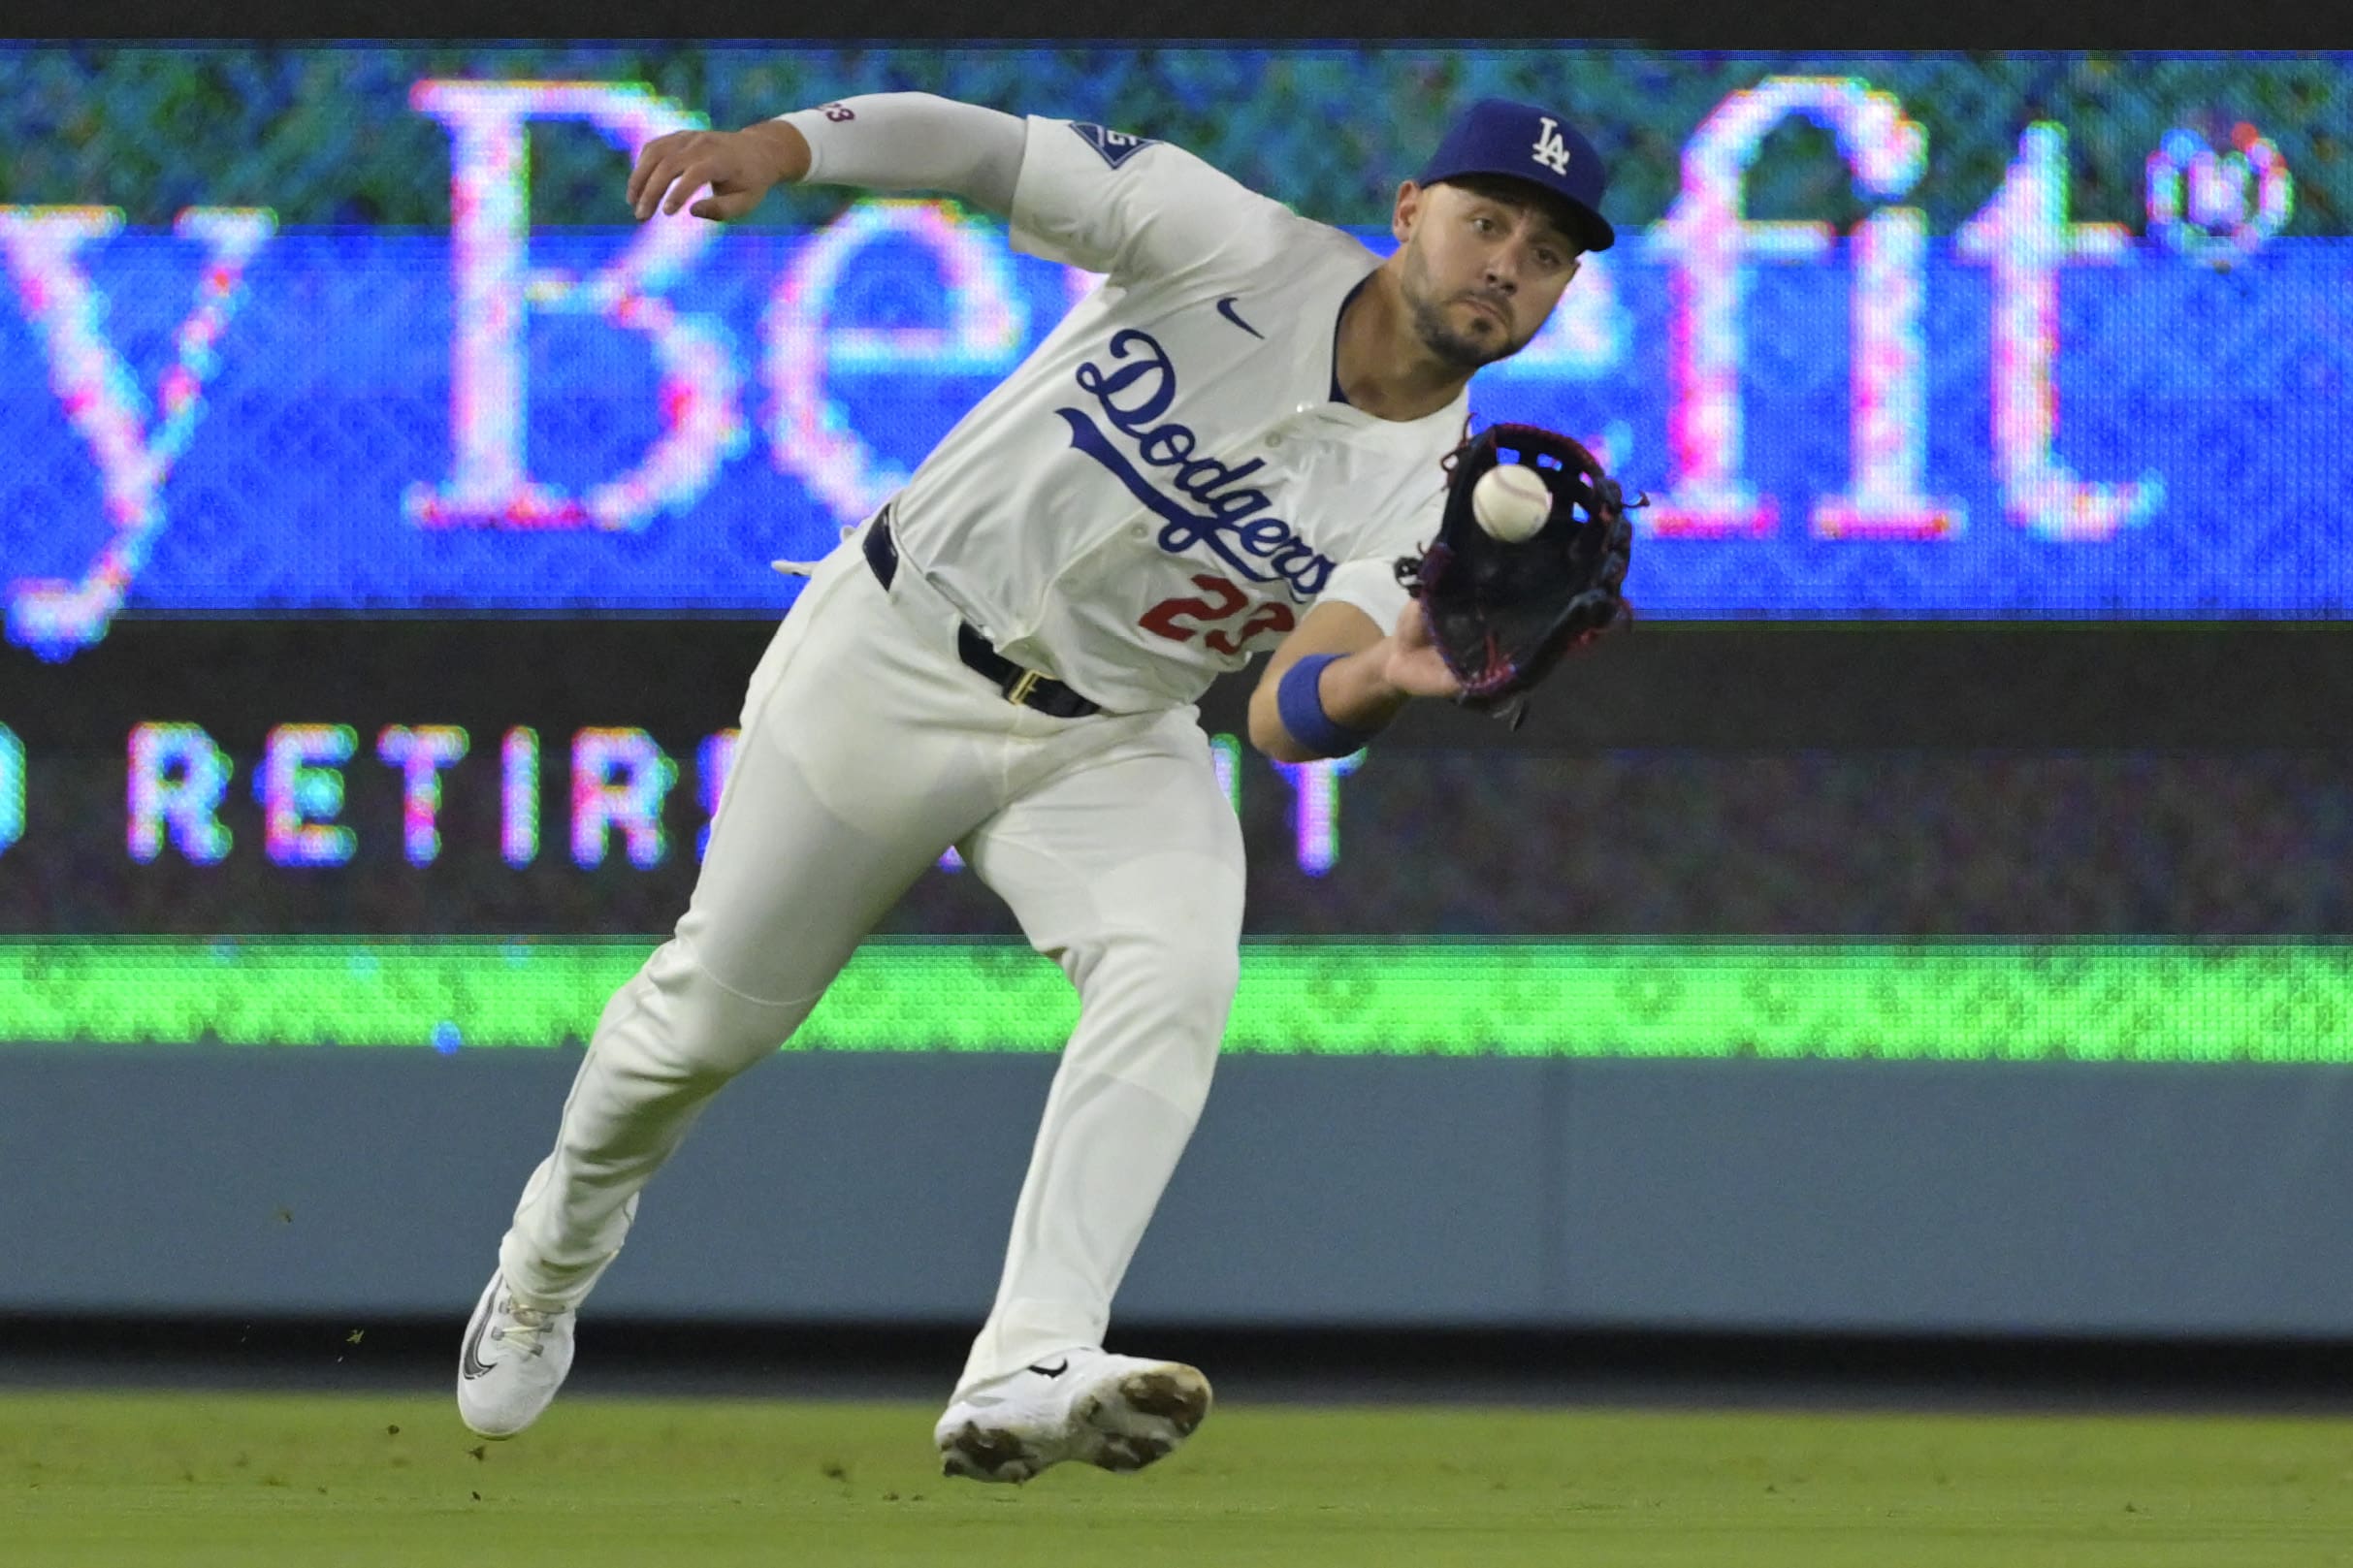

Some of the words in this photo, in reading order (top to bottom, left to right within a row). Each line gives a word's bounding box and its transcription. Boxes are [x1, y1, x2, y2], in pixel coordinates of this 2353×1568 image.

[1531, 116, 1570, 176] LA
[1054, 328, 1338, 603] Dodgers
[1138, 574, 1295, 656] 23
